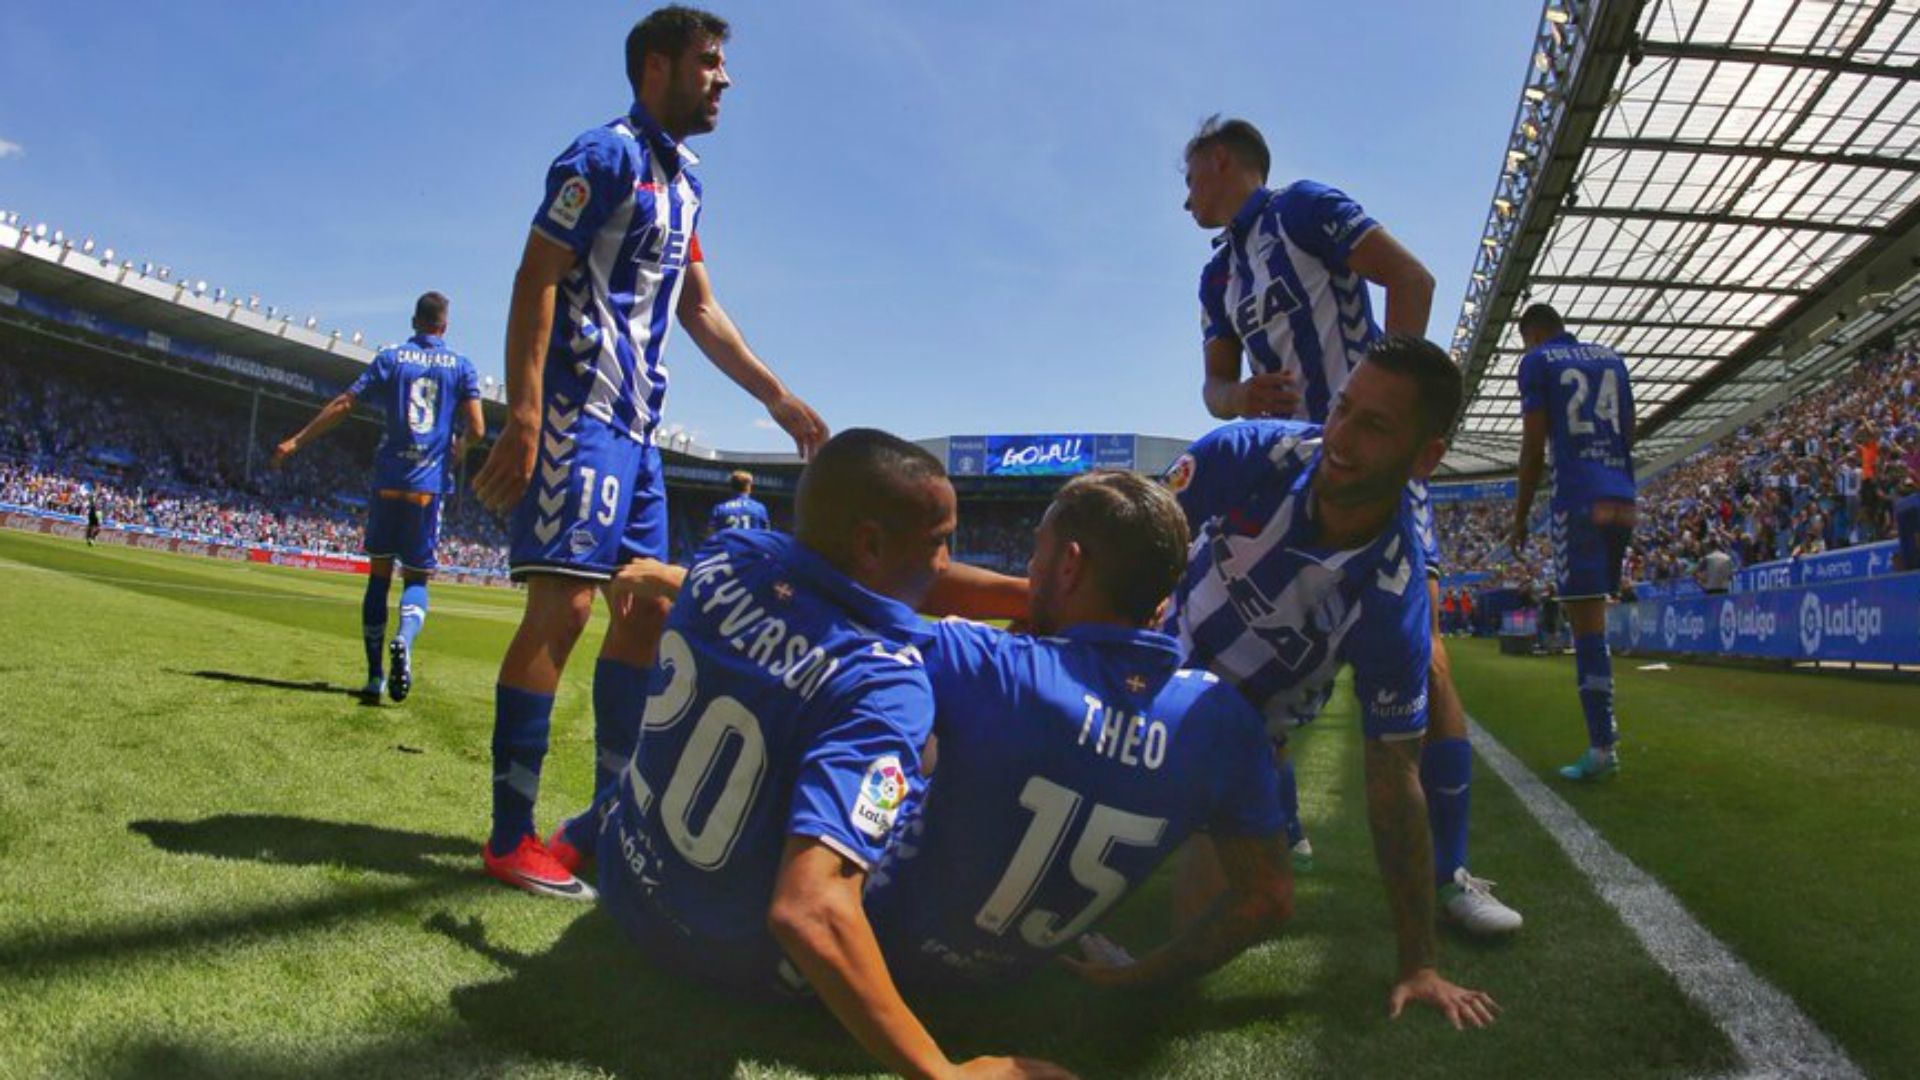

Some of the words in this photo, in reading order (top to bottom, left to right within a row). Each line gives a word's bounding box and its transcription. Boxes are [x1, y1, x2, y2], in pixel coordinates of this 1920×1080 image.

[408, 376, 439, 435] 8
[1560, 367, 1621, 435] 24
[579, 466, 620, 527] 19
[1211, 532, 1313, 671] LEA
[1738, 604, 1776, 642] LaLiga
[1824, 599, 1881, 644] LaLiga
[630, 630, 768, 871] 20
[1078, 694, 1167, 769] THEO
[975, 776, 1167, 949] 15
